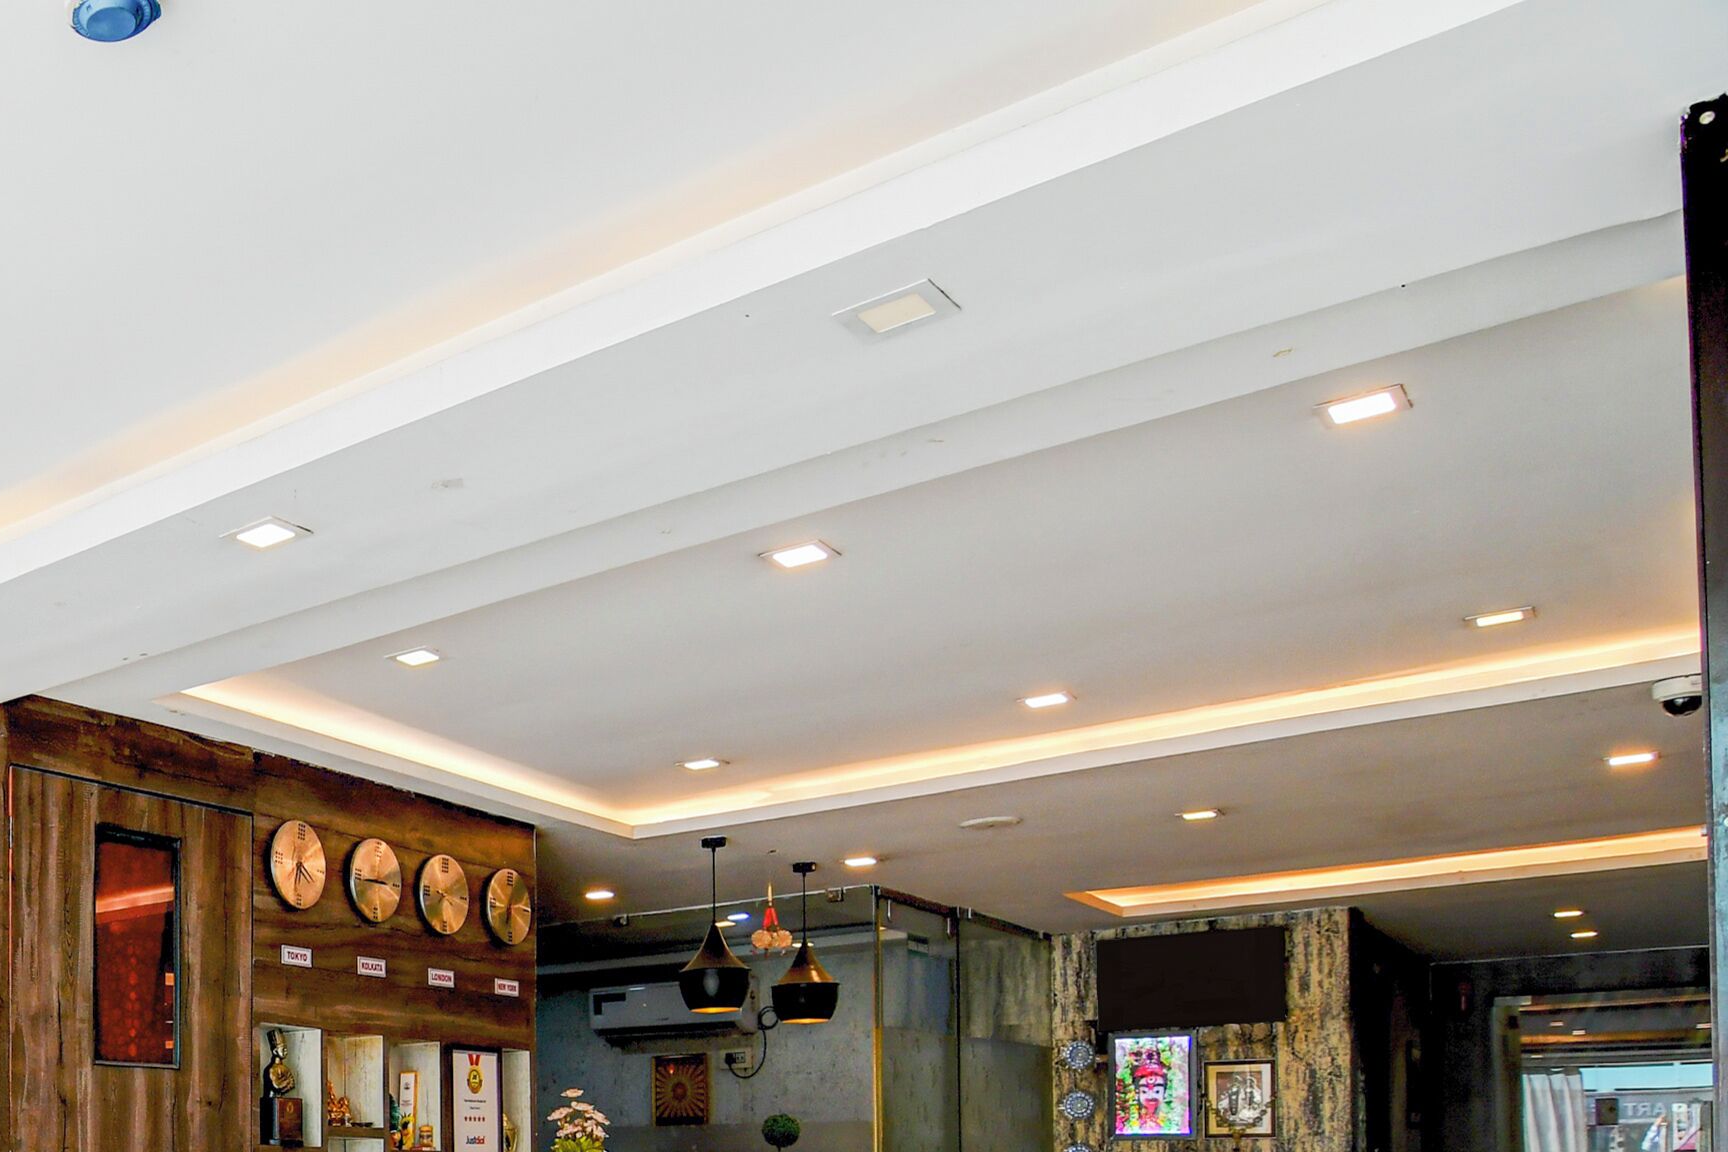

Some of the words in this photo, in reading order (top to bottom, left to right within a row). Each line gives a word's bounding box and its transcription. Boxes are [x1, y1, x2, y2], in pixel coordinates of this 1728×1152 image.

[287, 951, 308, 962] TOKYO
[362, 962, 383, 972] KOLKATA
[432, 973, 452, 983] LONDON
[497, 983, 506, 991] NEW
[507, 984, 517, 992] YORK
